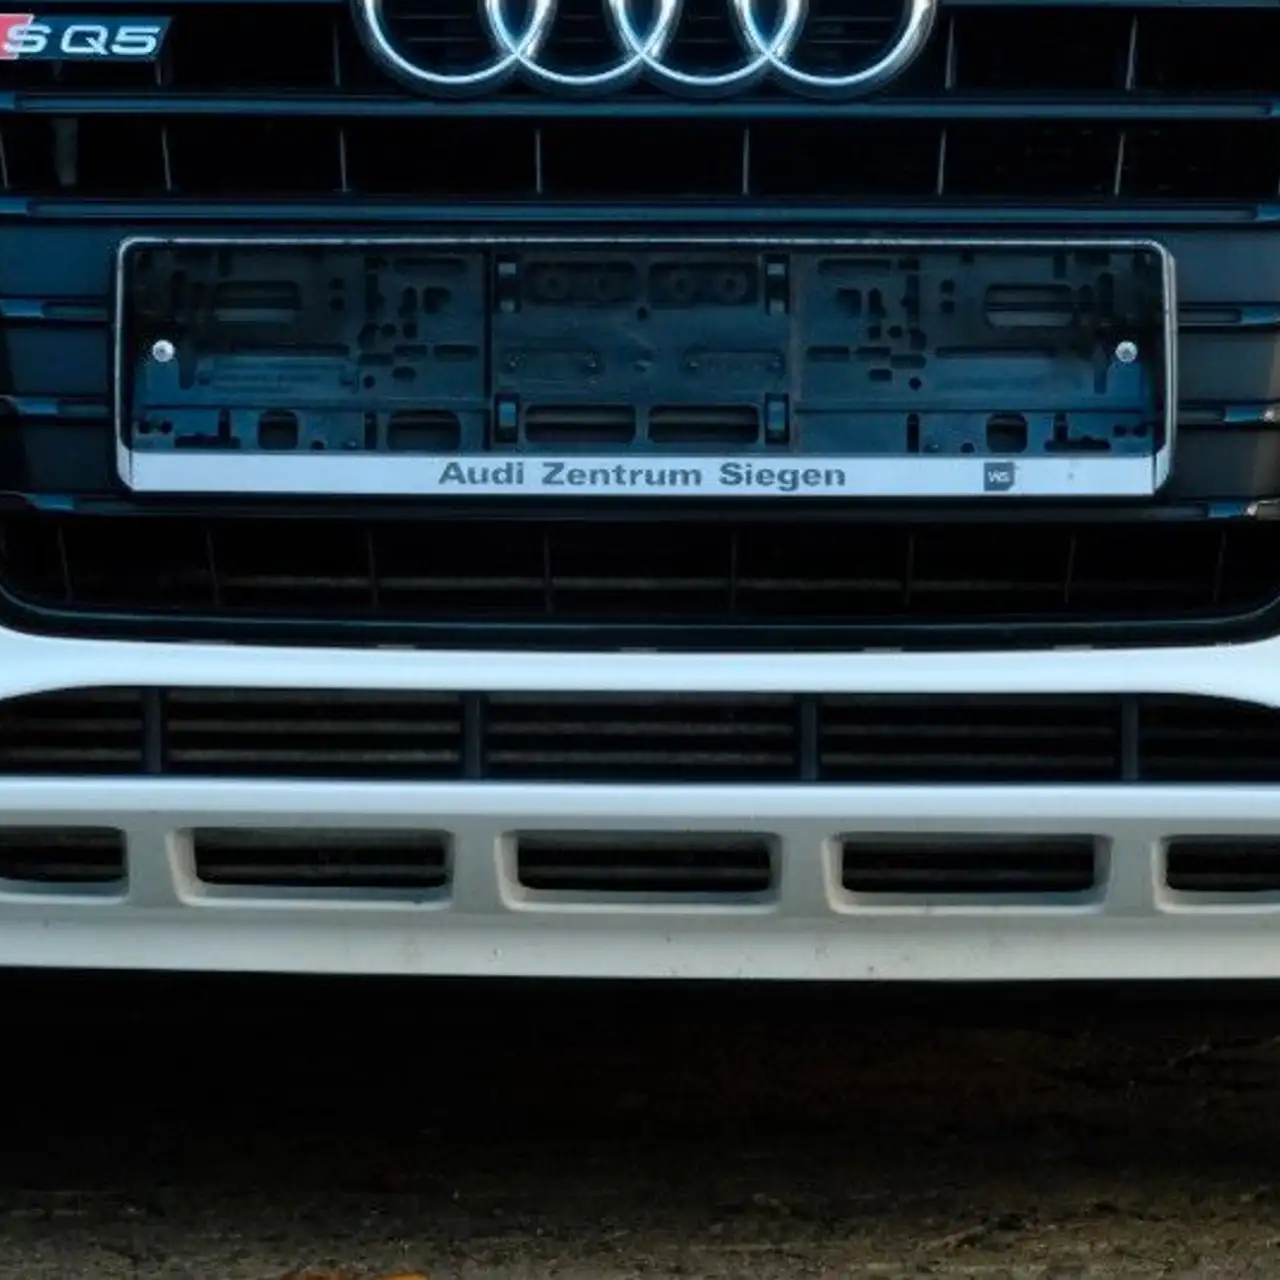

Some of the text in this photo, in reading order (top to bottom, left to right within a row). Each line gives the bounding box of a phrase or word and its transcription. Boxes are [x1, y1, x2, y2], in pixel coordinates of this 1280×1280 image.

[438, 462, 846, 491] Audi Zentrum Siegen
